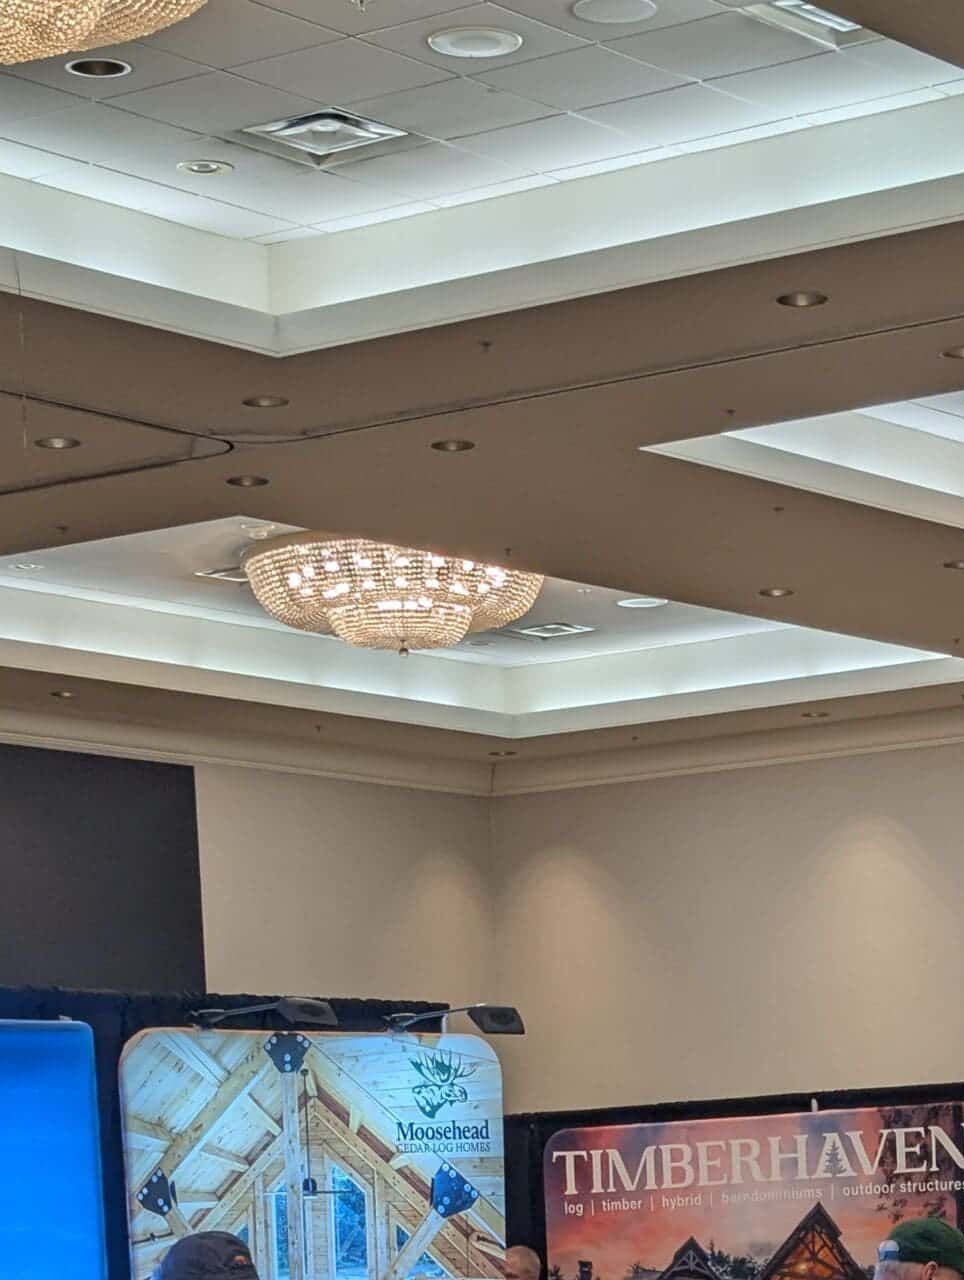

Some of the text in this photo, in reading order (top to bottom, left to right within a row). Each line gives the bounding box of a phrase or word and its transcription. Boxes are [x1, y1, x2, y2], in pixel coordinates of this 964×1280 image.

[396, 1120, 490, 1141] Moosehead
[397, 1142, 490, 1153] CEDAR LOG HOMES
[564, 1202, 584, 1216] log
[602, 1198, 642, 1212] timber
[662, 1193, 702, 1209] hybrid
[843, 1182, 895, 1196] outdoor
